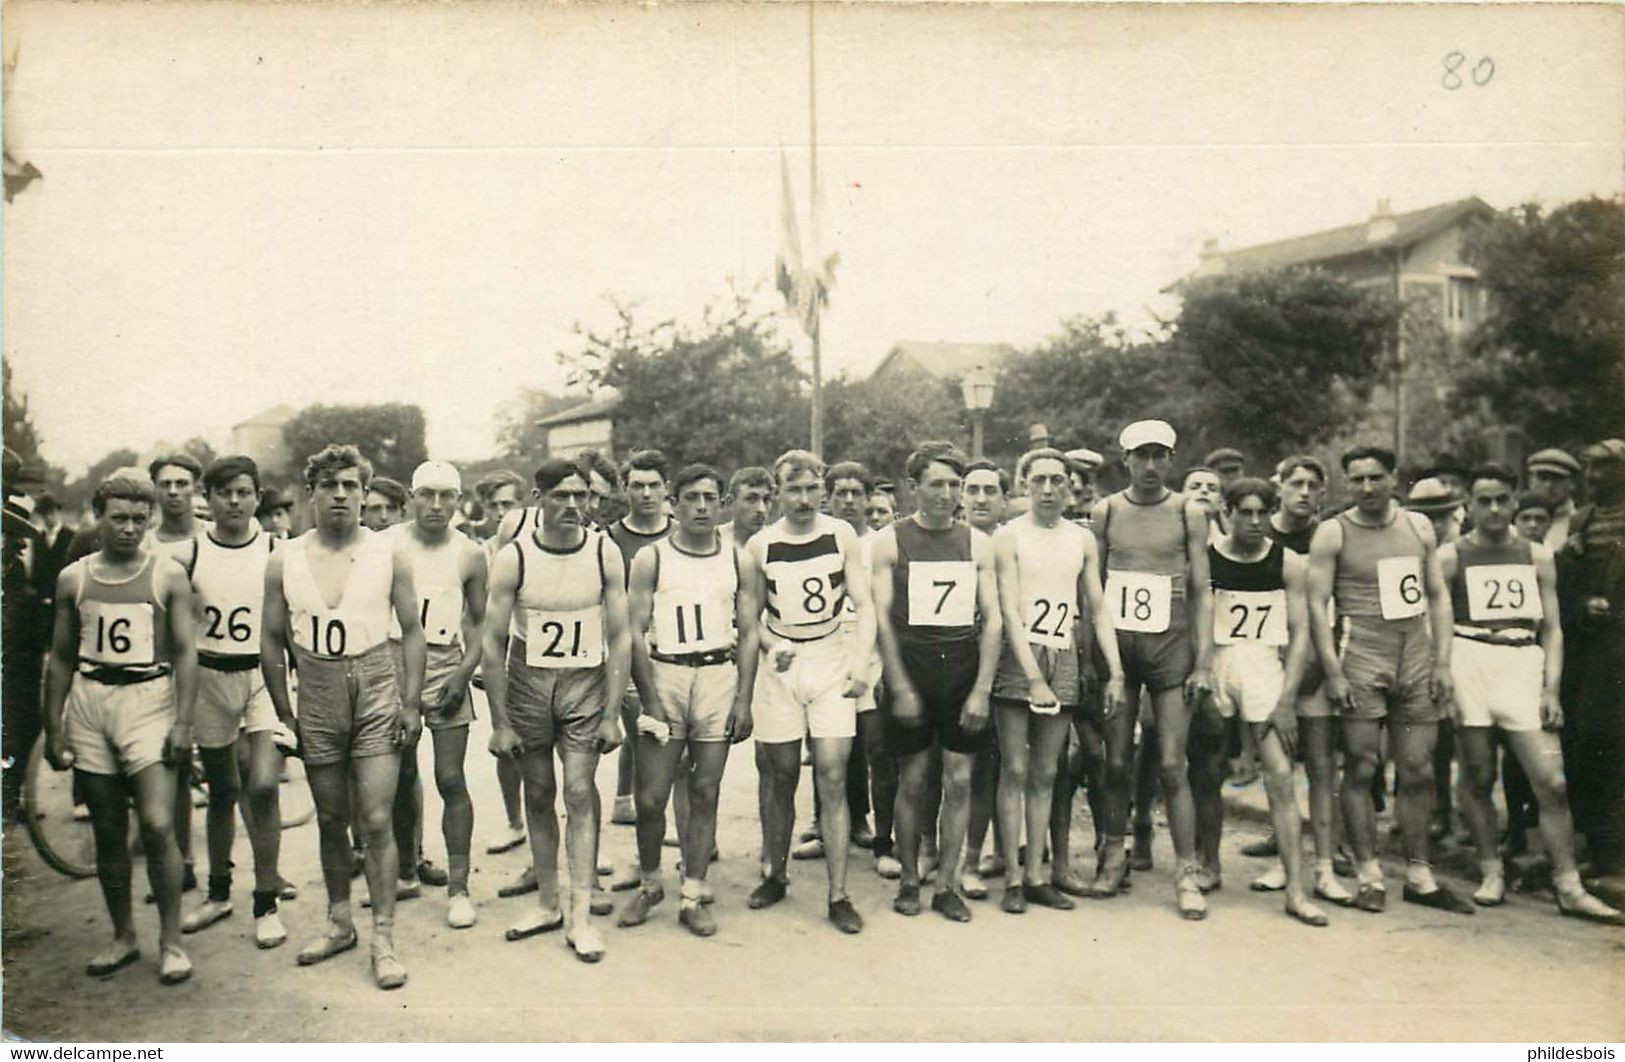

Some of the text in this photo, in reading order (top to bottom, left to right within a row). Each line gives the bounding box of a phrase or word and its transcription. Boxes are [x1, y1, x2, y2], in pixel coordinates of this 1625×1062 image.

[1442, 50, 1496, 91] 80
[802, 576, 827, 614] 8
[932, 580, 957, 615] 7
[1120, 586, 1153, 621] 18
[1398, 573, 1423, 606] 6
[1484, 579, 1526, 610] 29
[96, 615, 132, 655] 16
[203, 605, 252, 643] 26
[310, 615, 347, 657] 10
[676, 603, 705, 644] 11
[1030, 598, 1070, 638] 22
[1229, 604, 1273, 640] 27
